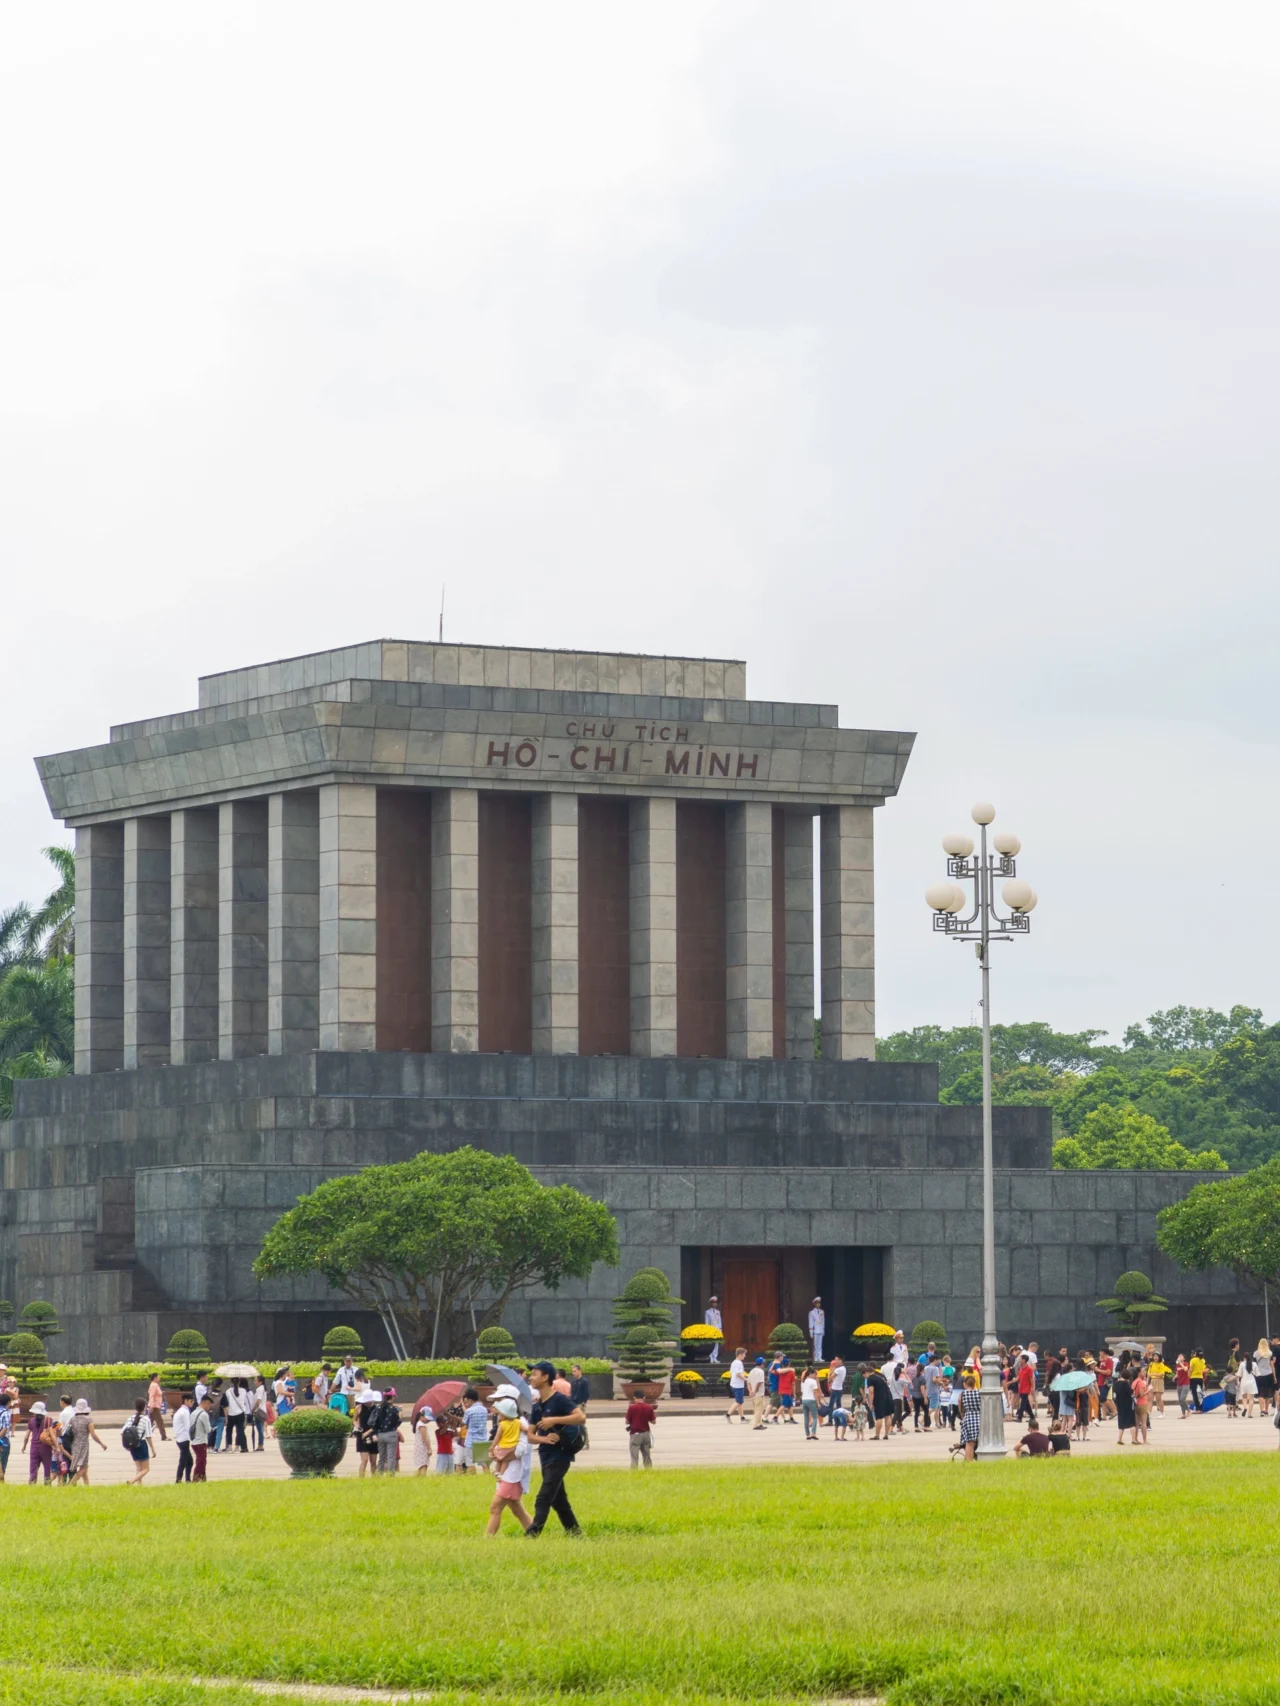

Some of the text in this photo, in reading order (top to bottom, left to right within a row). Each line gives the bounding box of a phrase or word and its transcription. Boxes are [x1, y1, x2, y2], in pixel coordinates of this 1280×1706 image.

[635, 721, 689, 746] TỊCH
[486, 737, 541, 767] HỒ
[570, 742, 633, 772] CHÍ
[665, 744, 759, 778] MINH
